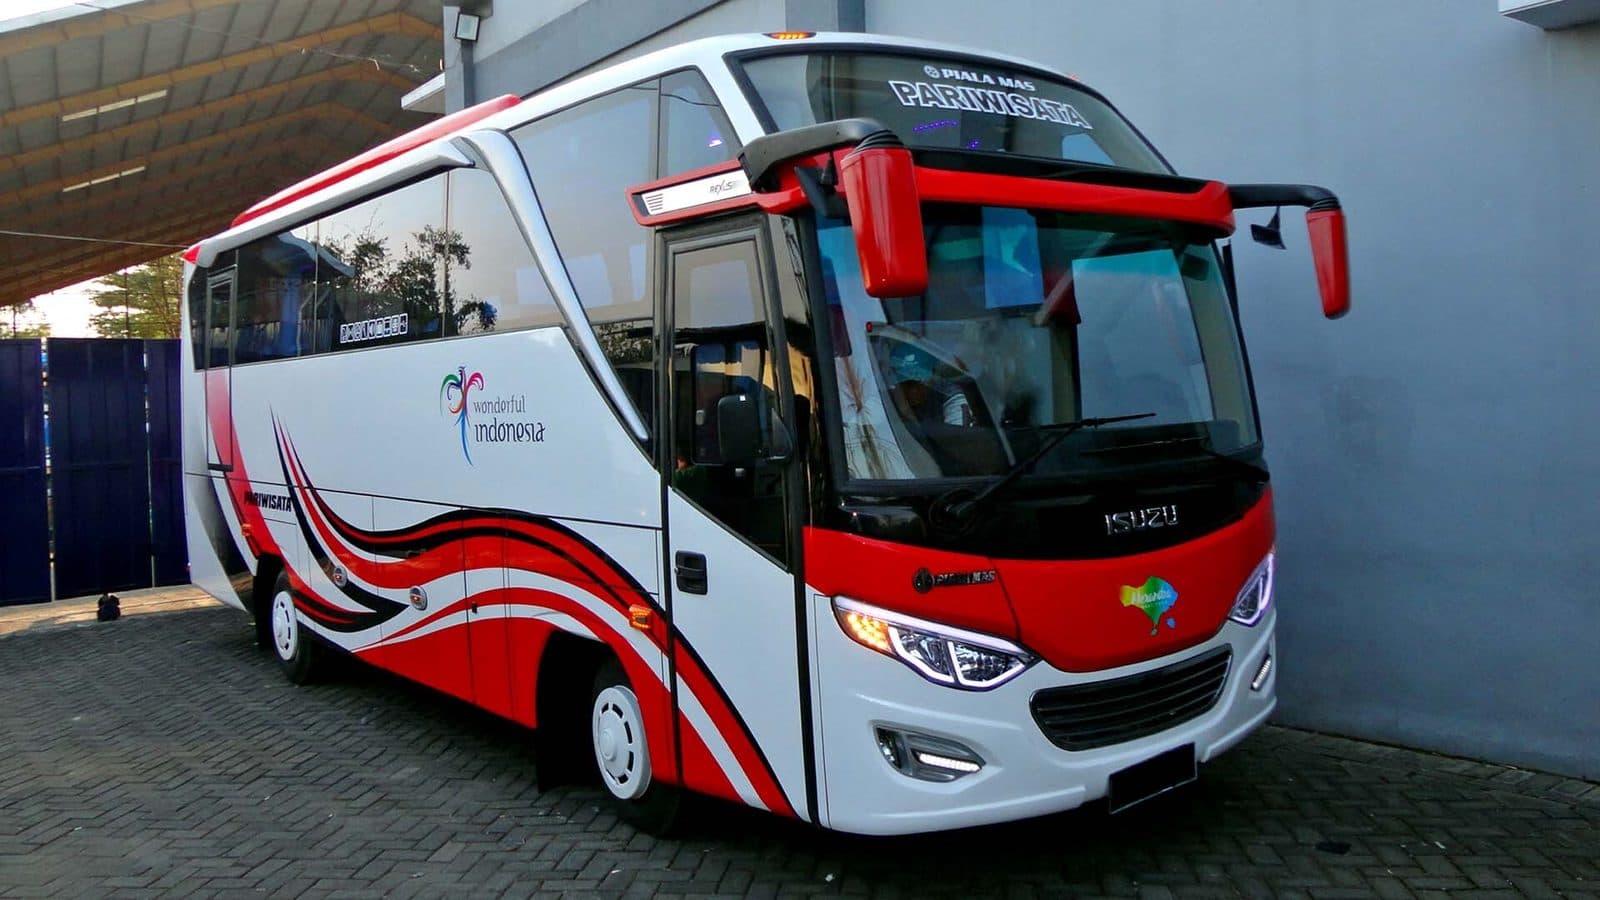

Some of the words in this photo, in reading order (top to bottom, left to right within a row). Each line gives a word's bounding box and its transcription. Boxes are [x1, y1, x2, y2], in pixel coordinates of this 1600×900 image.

[941, 68, 996, 85] PIALA
[997, 76, 1036, 92] MAS
[888, 80, 1093, 130] PARIWISATA
[473, 394, 526, 414] wonderful
[474, 416, 546, 443] indonesia
[1104, 504, 1178, 536] ISUZU
